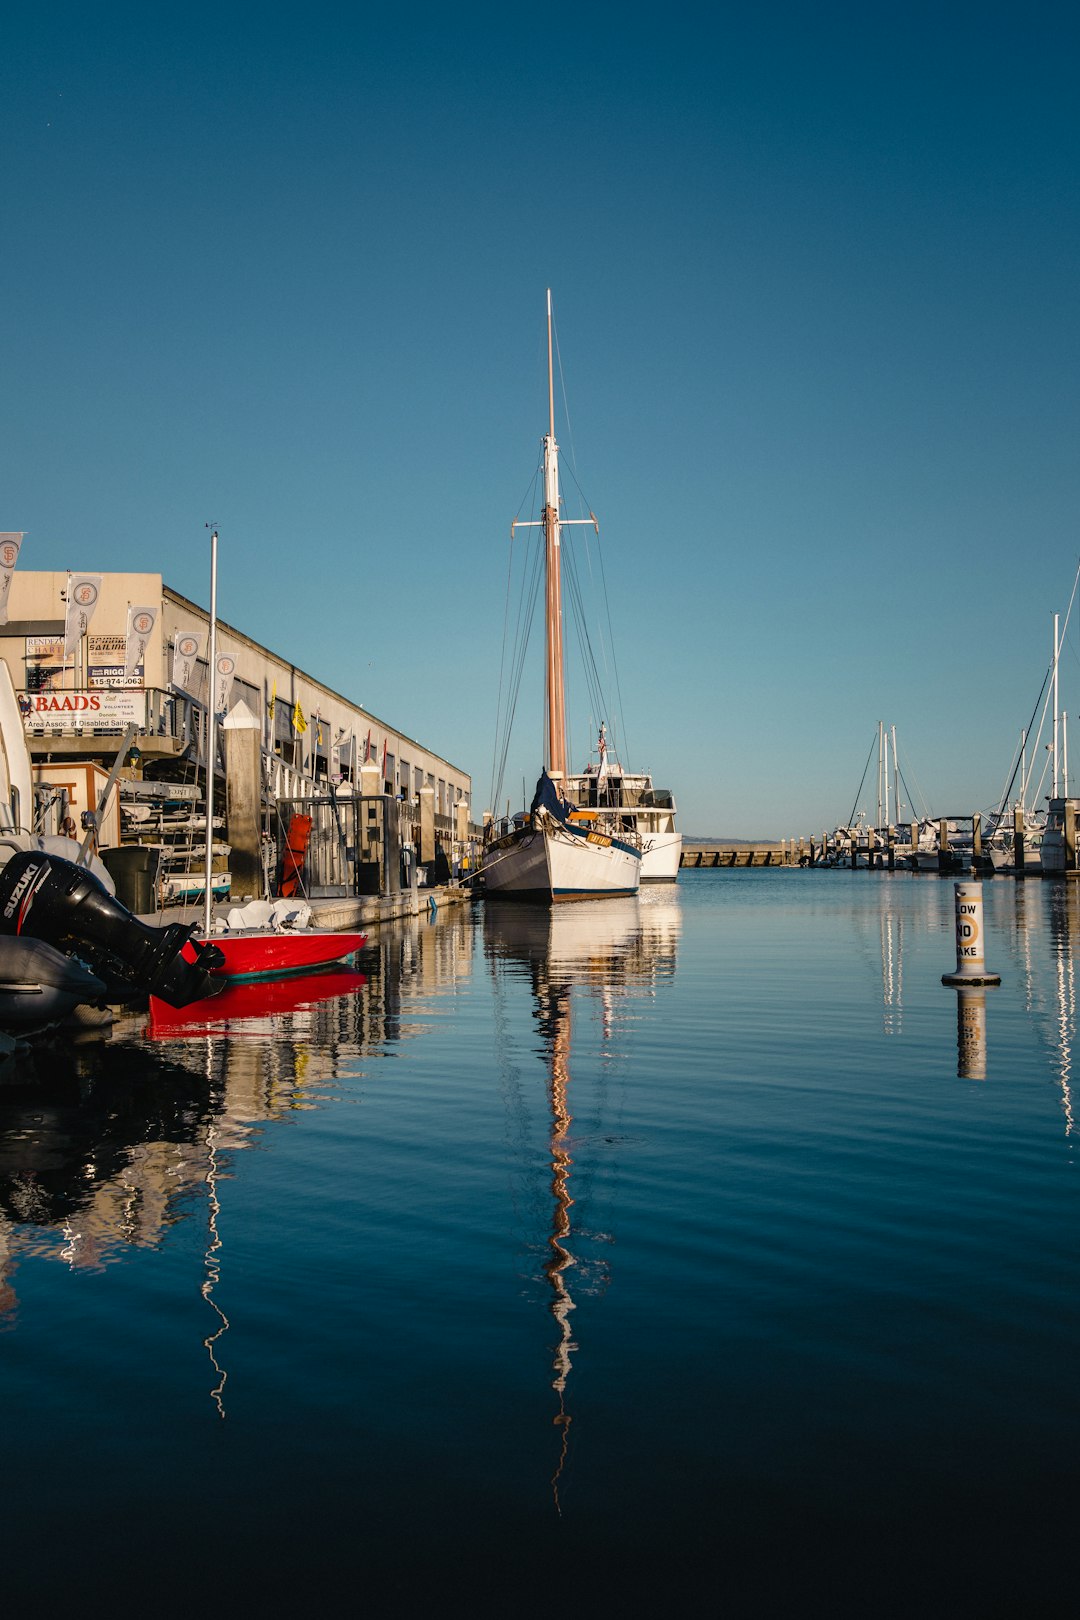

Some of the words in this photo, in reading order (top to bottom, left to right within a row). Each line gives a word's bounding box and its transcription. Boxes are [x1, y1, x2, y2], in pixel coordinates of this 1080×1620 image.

[28, 638, 64, 646] RENDEZV
[103, 668, 140, 676] RIGGS
[35, 695, 101, 712] BAADS
[4, 863, 39, 918] SUZUKI
[955, 905, 976, 914] LOW
[956, 925, 971, 937] NO
[956, 947, 977, 956] AKE
